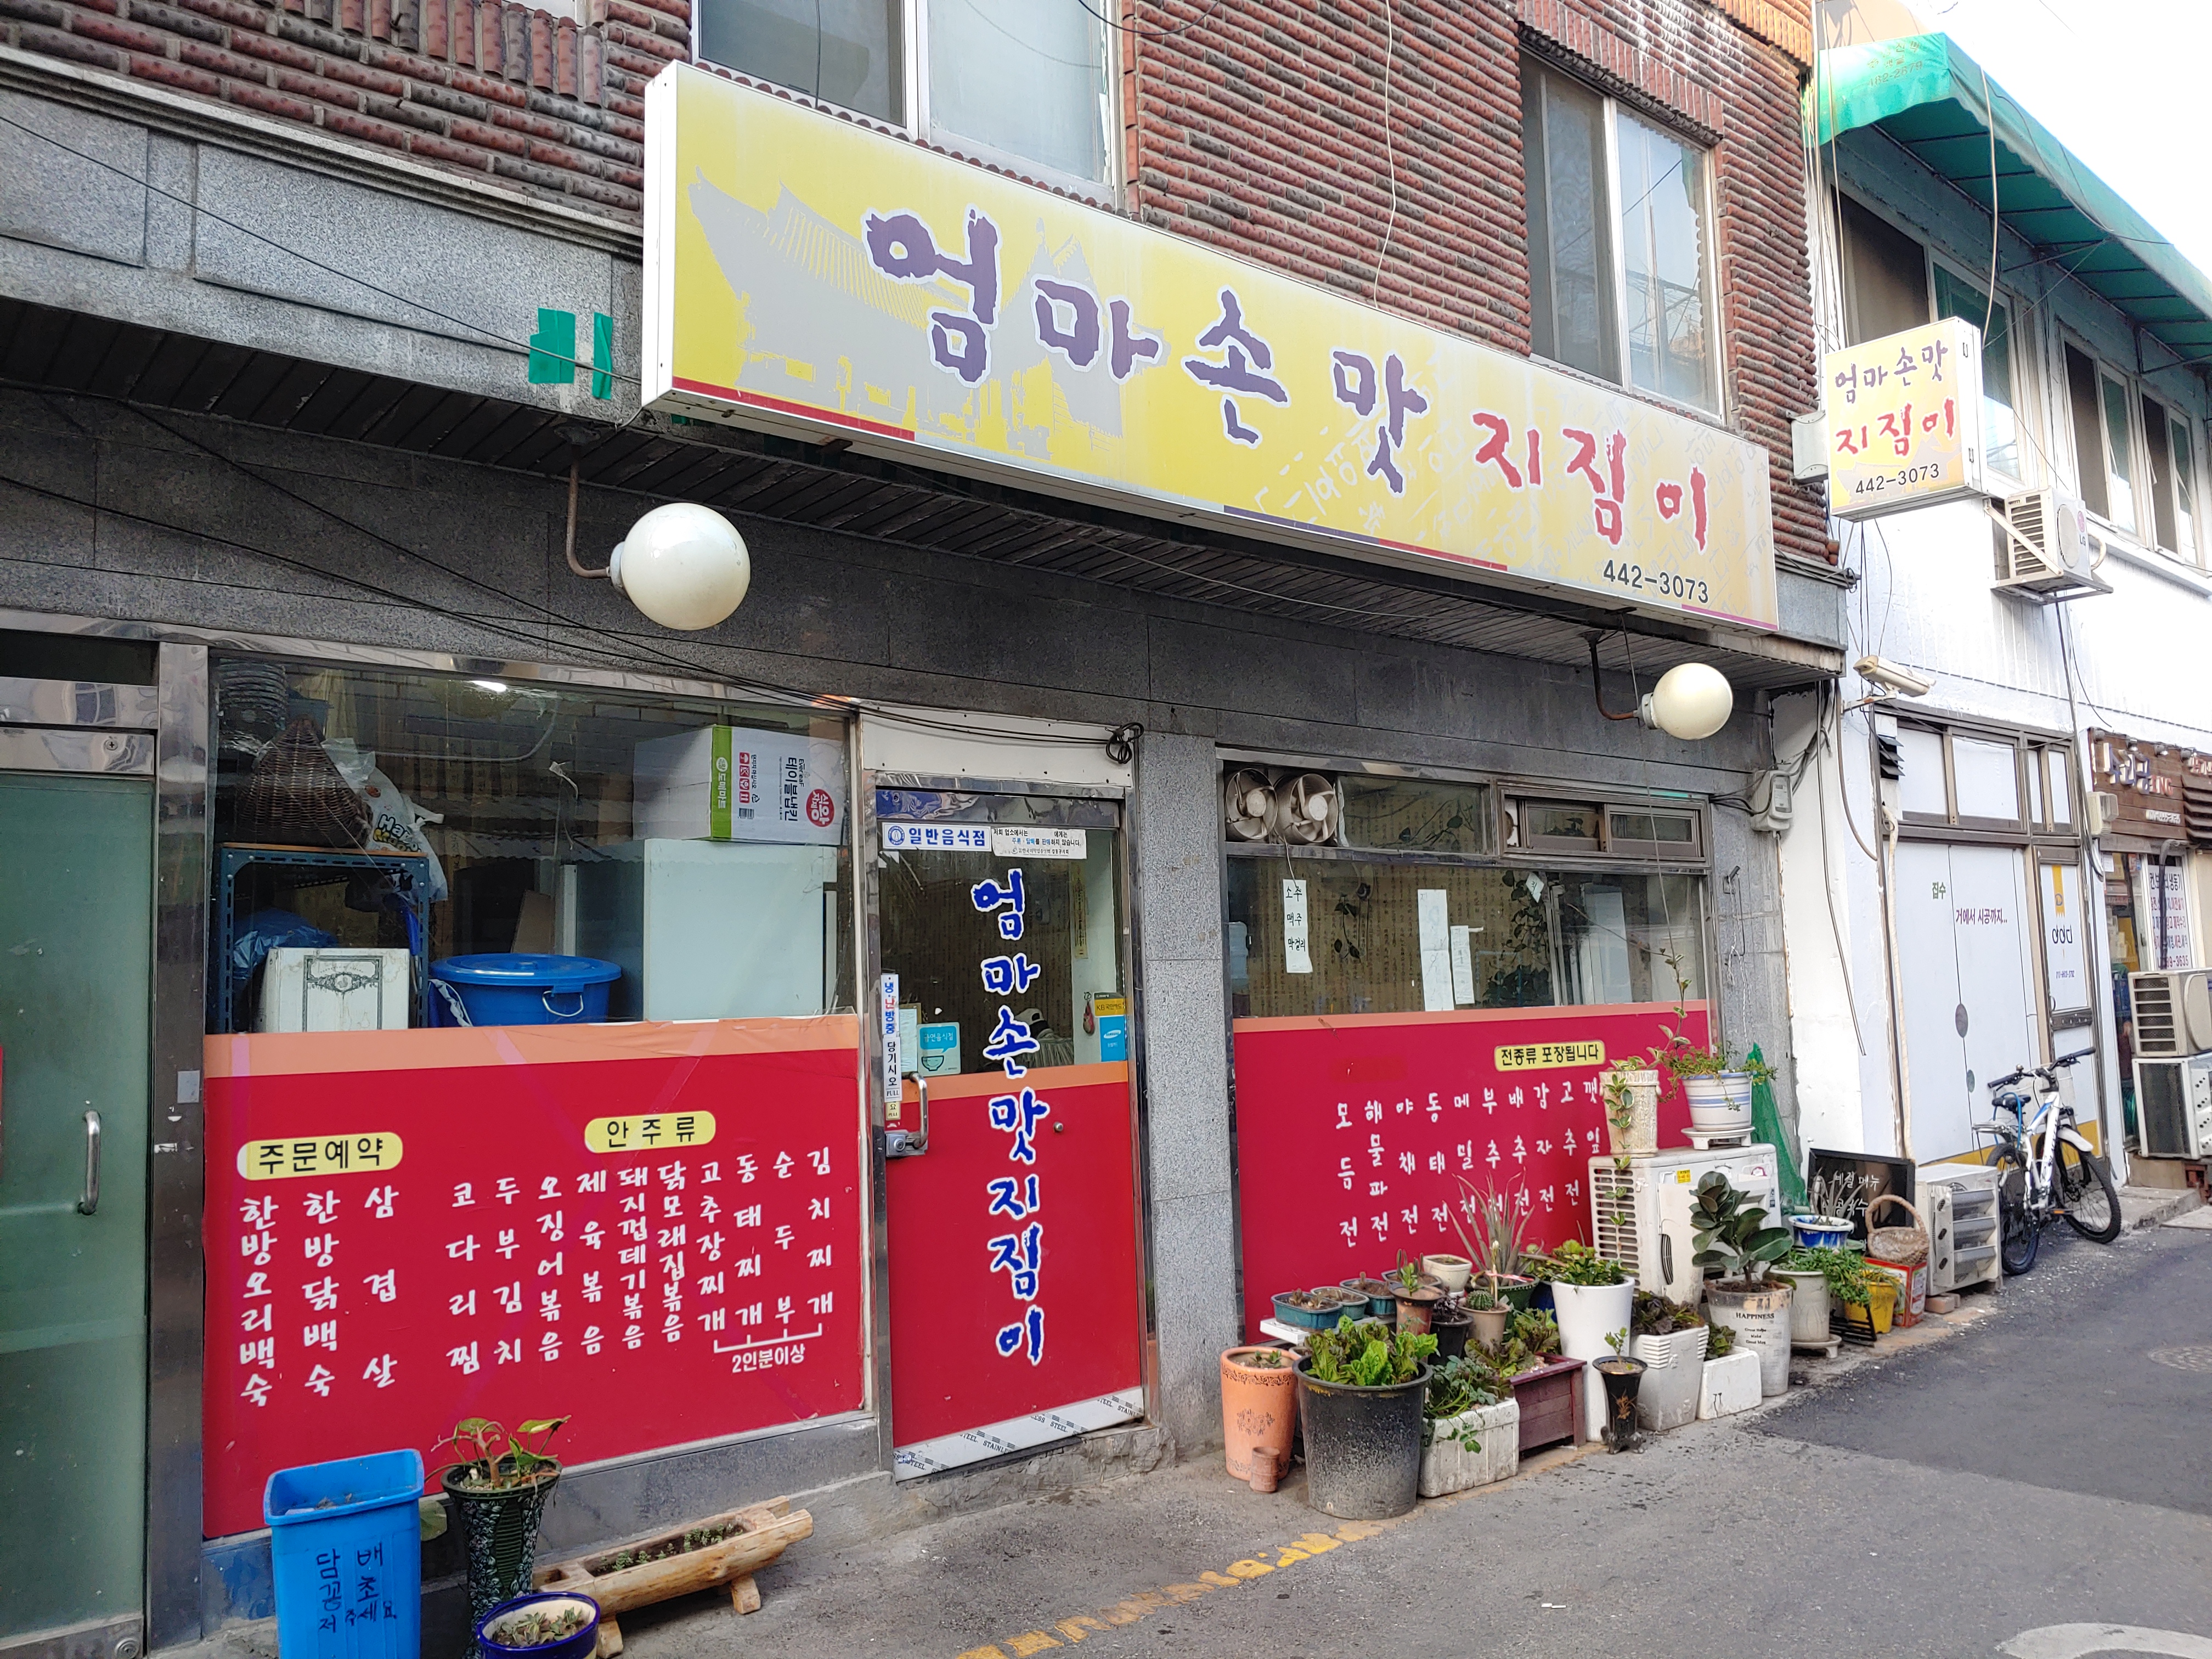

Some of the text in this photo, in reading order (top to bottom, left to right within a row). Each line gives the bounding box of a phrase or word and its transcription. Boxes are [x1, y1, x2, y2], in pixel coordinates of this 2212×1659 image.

[866, 208, 1427, 494] 엄마손맛
[1472, 411, 1707, 550] 지짐이
[1835, 340, 1948, 404] 엄마손맛
[1835, 398, 1955, 456] 지짐이
[1855, 463, 1939, 494] 442-3073
[1603, 558, 1709, 603] 442-3073
[718, 772, 726, 809] 도매마트
[784, 757, 798, 821] 테이블냅킨
[909, 827, 985, 847] 일반음식점
[1285, 885, 1302, 901] 소주
[1287, 912, 1302, 927] 맥주
[1288, 936, 1306, 952] 막걸리
[888, 1041, 898, 1087] 당기시오
[1501, 1044, 1599, 1066] 전종류 포장됩니다
[607, 1116, 695, 1148] 안주류
[259, 1138, 383, 1174] 주문예약
[732, 1344, 805, 1373] 2인분이상
